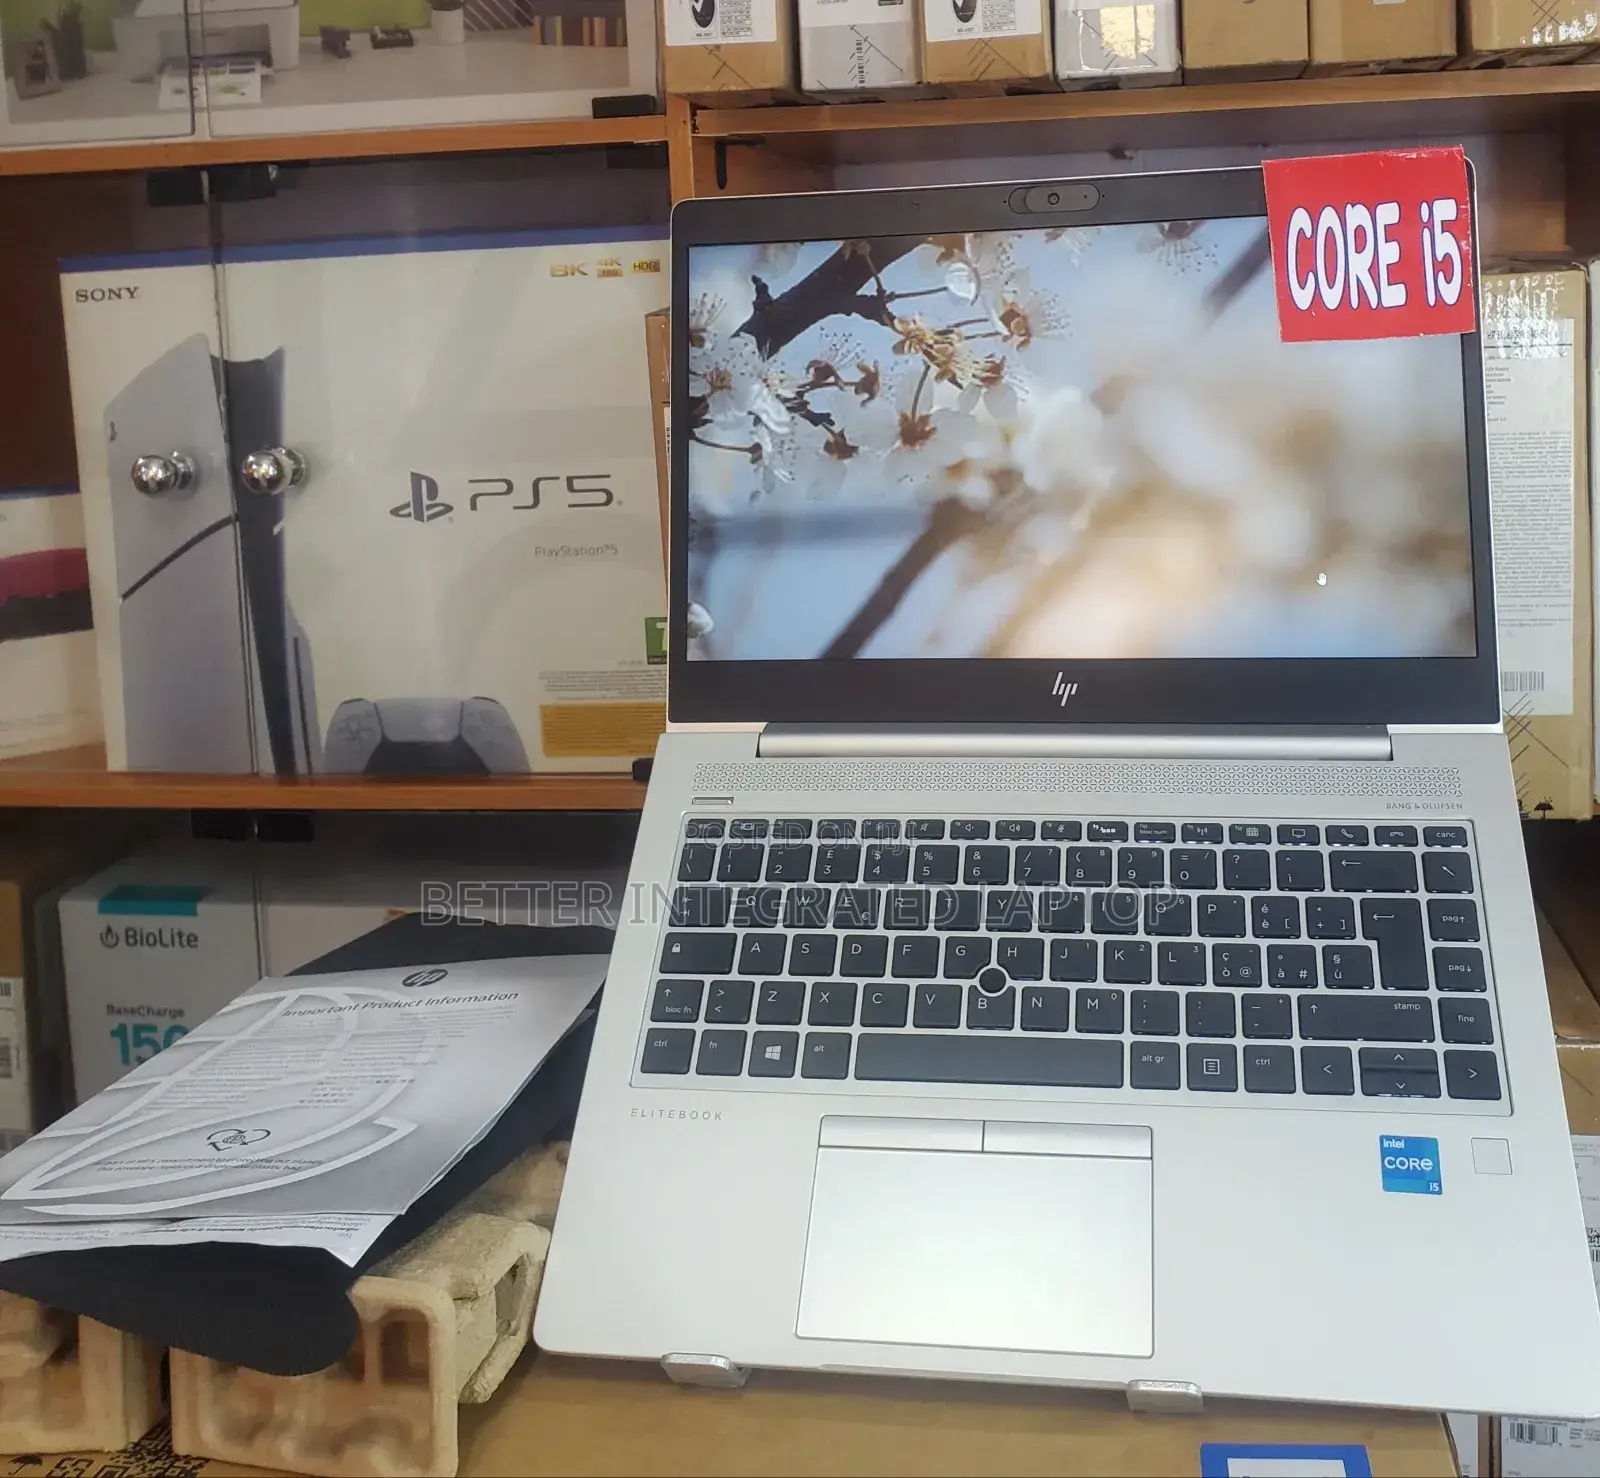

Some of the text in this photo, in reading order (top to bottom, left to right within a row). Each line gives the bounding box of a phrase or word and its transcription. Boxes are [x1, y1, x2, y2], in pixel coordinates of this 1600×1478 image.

[1287, 198, 1463, 311] CORE i5
[75, 286, 139, 303] SONY
[468, 473, 614, 512] PS5
[1386, 802, 1411, 810] BANG
[1421, 802, 1463, 810] OLUFSEN
[774, 865, 782, 874] 2
[824, 865, 832, 874] 3
[872, 866, 881, 875] 4
[922, 867, 930, 876] 5
[972, 867, 981, 876] 6
[1024, 868, 1032, 877] 7
[1076, 869, 1084, 878] 8
[1128, 870, 1136, 879] 9
[894, 898, 903, 908] R
[998, 899, 1007, 909] Y
[1207, 904, 1217, 914] P
[124, 926, 198, 950] BioLite
[750, 943, 761, 953] A
[801, 943, 810, 954] S
[851, 944, 862, 954] D
[902, 945, 912, 955] F
[956, 945, 966, 956] G
[1007, 947, 1017, 957] H
[1060, 948, 1068, 959] J
[1114, 950, 1125, 960] K
[1168, 951, 1177, 962] L
[767, 990, 777, 1001] Z
[819, 992, 830, 1003] X
[872, 993, 883, 1004] C
[925, 993, 936, 1005] V
[282, 992, 519, 1017] Important Product Information
[977, 998, 988, 1009] B
[1031, 997, 1042, 1008] N
[1087, 998, 1098, 1009] M
[1393, 1002, 1421, 1011] stamp
[106, 1004, 185, 1019] BaseCharge
[665, 1005, 692, 1013] bloc fn
[1457, 1014, 1475, 1023] fine
[653, 1039, 668, 1047] ctrl
[709, 1040, 718, 1049] fn
[813, 1044, 825, 1052] alt
[1141, 1054, 1165, 1063] alt gr
[1255, 1057, 1271, 1066] ctrl
[630, 1108, 723, 1121] ELITEBOOK
[1383, 1138, 1405, 1149] intel
[1429, 1182, 1440, 1191] i5
